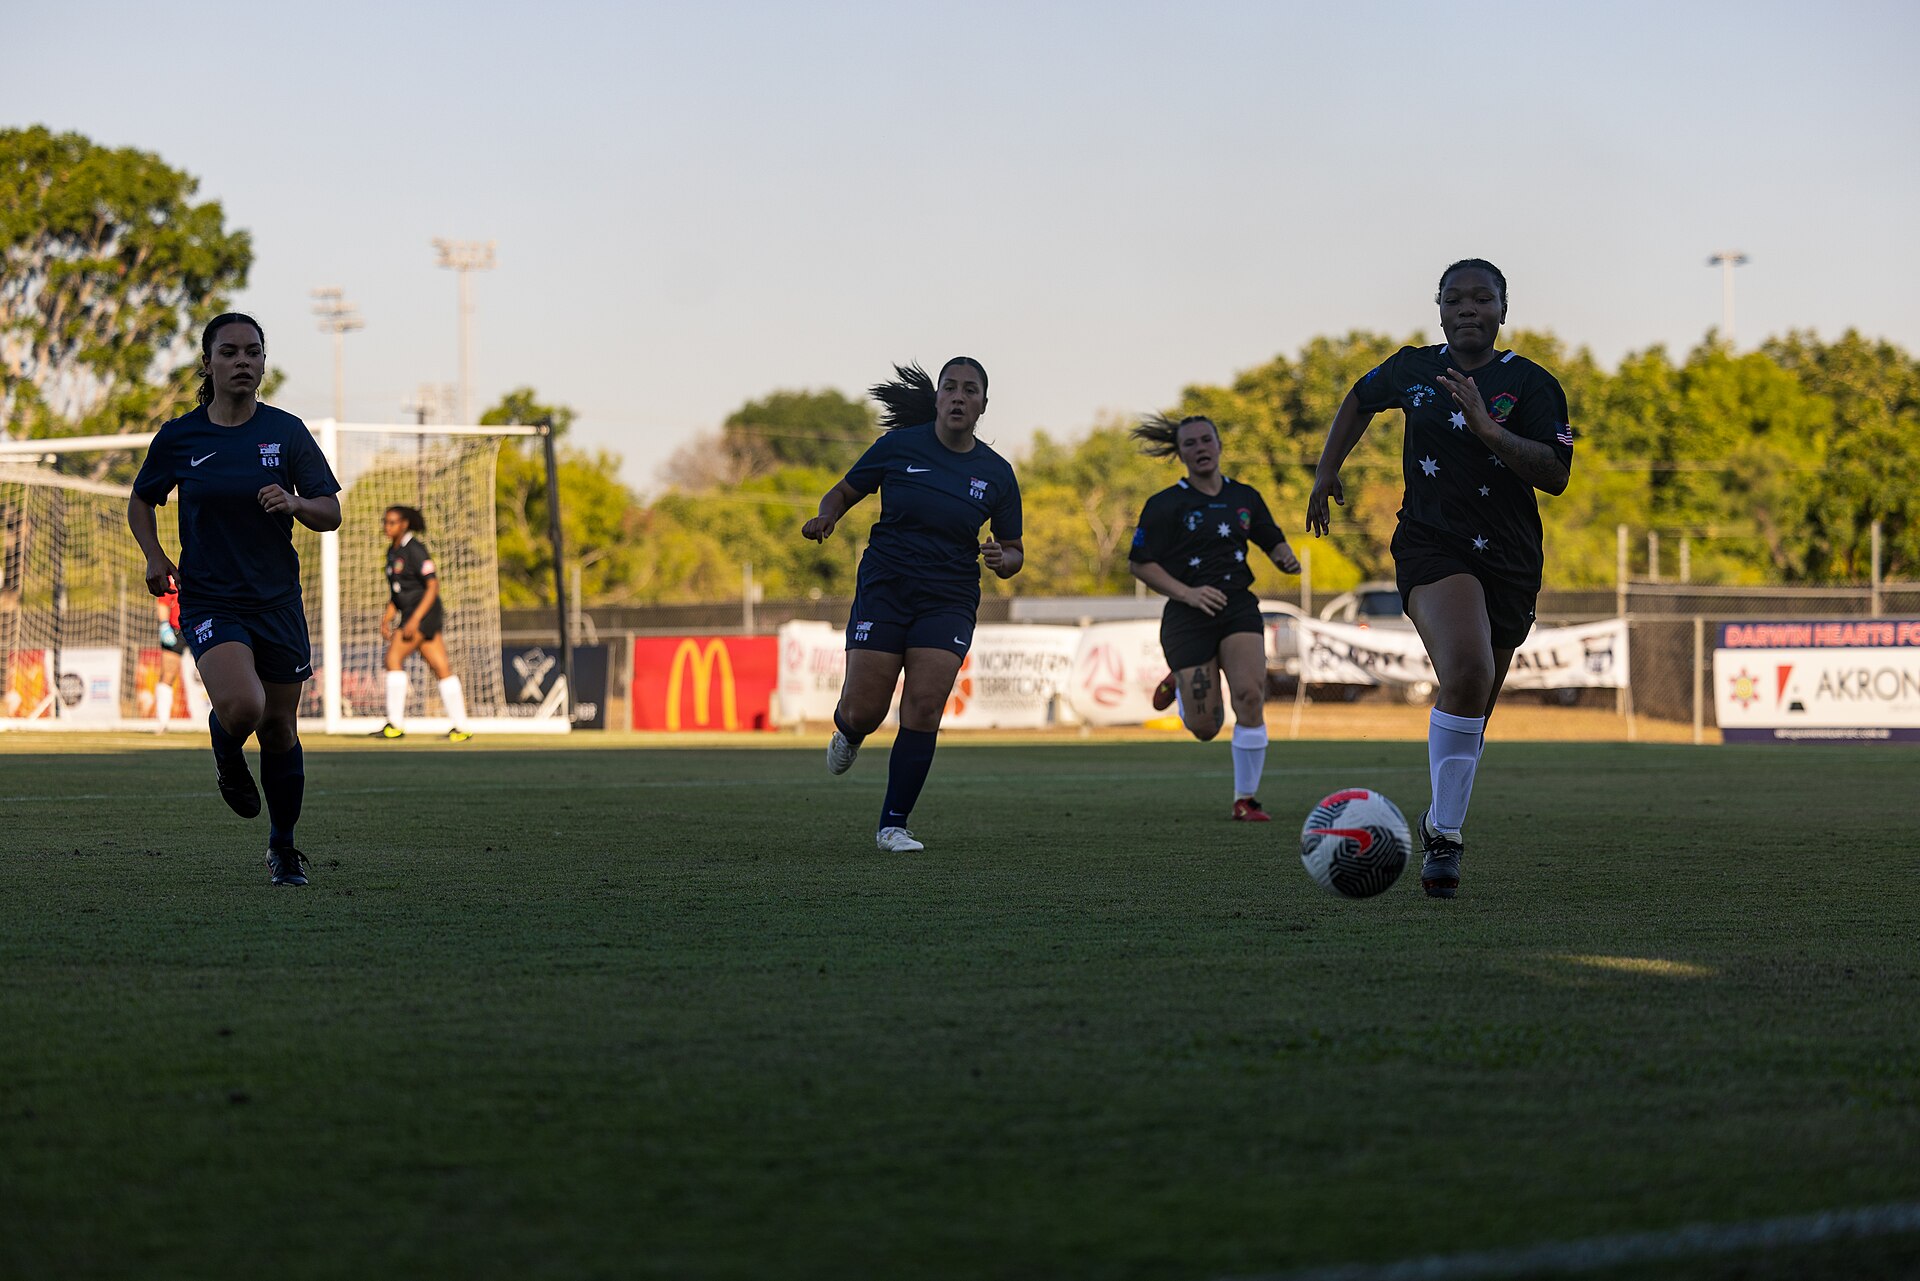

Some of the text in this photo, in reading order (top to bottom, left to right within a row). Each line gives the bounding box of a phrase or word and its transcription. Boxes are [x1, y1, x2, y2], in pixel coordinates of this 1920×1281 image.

[1725, 623, 1812, 648] DARWIN
[1814, 622, 1895, 647] HEARTS
[1816, 667, 1920, 701] AKRON
